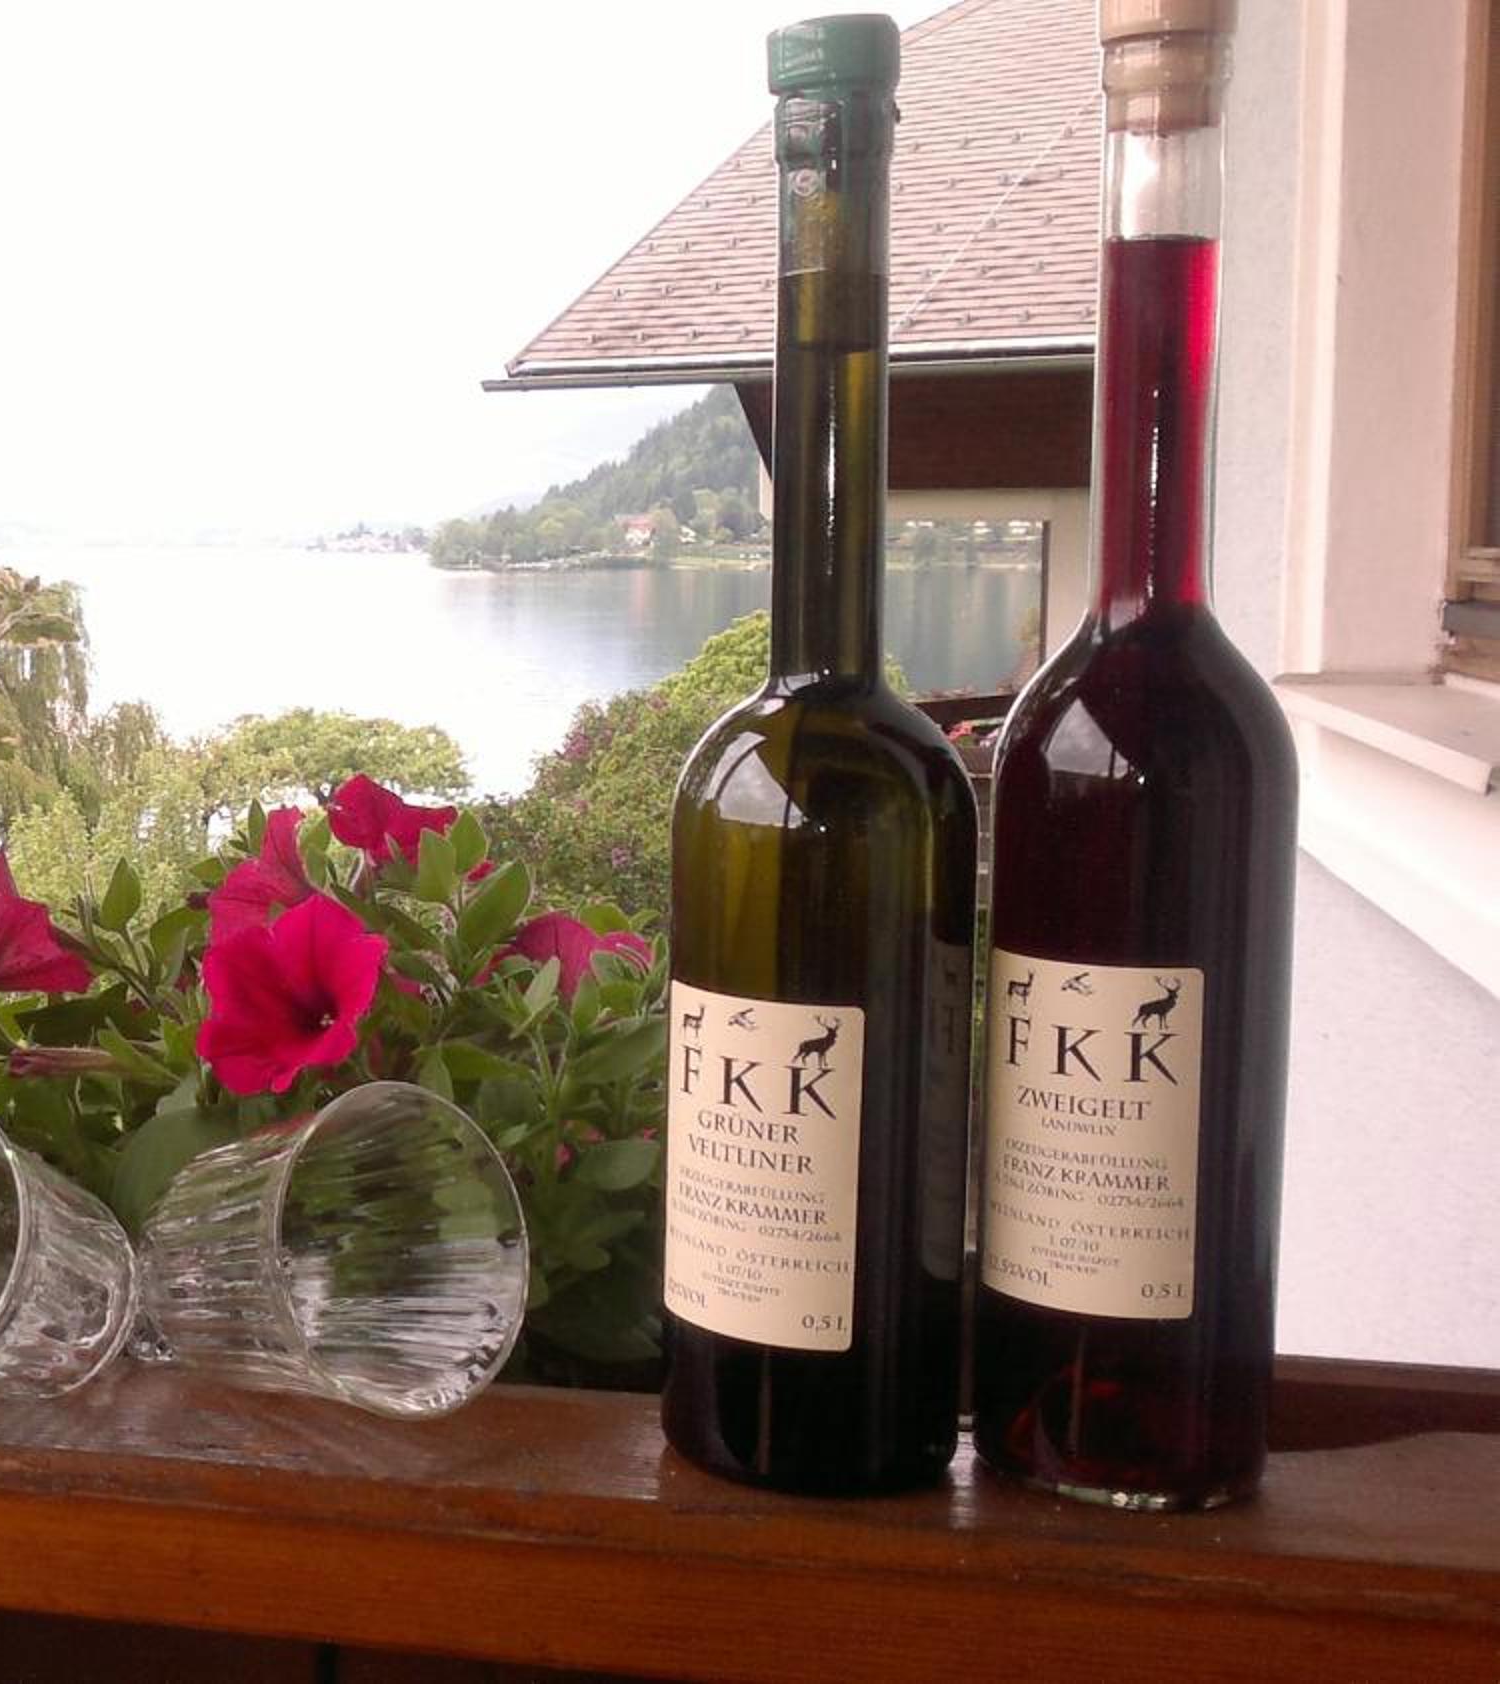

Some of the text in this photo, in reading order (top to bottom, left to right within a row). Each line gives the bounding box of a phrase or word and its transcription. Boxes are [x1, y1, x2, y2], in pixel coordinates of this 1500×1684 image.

[1016, 1085, 1150, 1121] ZWEIGELT
[697, 1109, 800, 1145] GRÜNER
[1041, 1117, 1116, 1137] LANDWEIN
[688, 1134, 815, 1176] VELTLINER
[1003, 1153, 1171, 1191] FRANZ KRAMMER
[726, 1198, 828, 1226] KRAMMER
[1071, 1219, 1189, 1240] ÖSTERREICH
[736, 1247, 850, 1273] ÖSTERREICH
